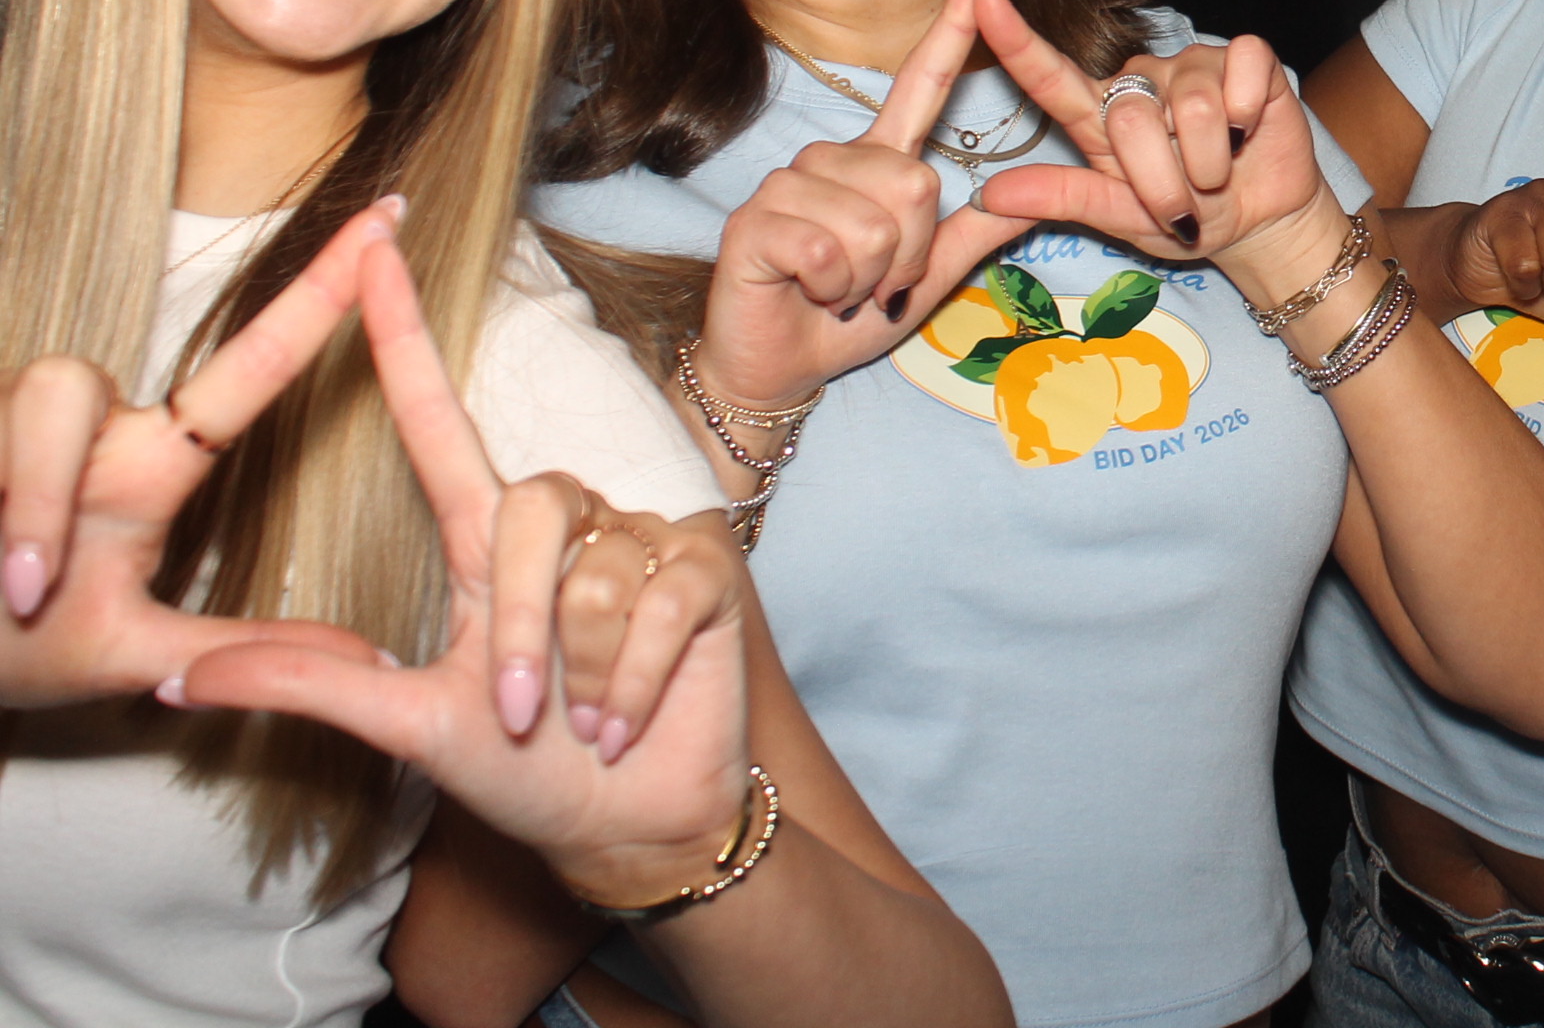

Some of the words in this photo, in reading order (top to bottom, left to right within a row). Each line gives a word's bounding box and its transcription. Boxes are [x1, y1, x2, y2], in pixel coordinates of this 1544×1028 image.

[1005, 228, 1086, 264] elta
[1093, 447, 1135, 470] BID
[1140, 431, 1186, 464] DAY
[1194, 407, 1250, 445] 2026
